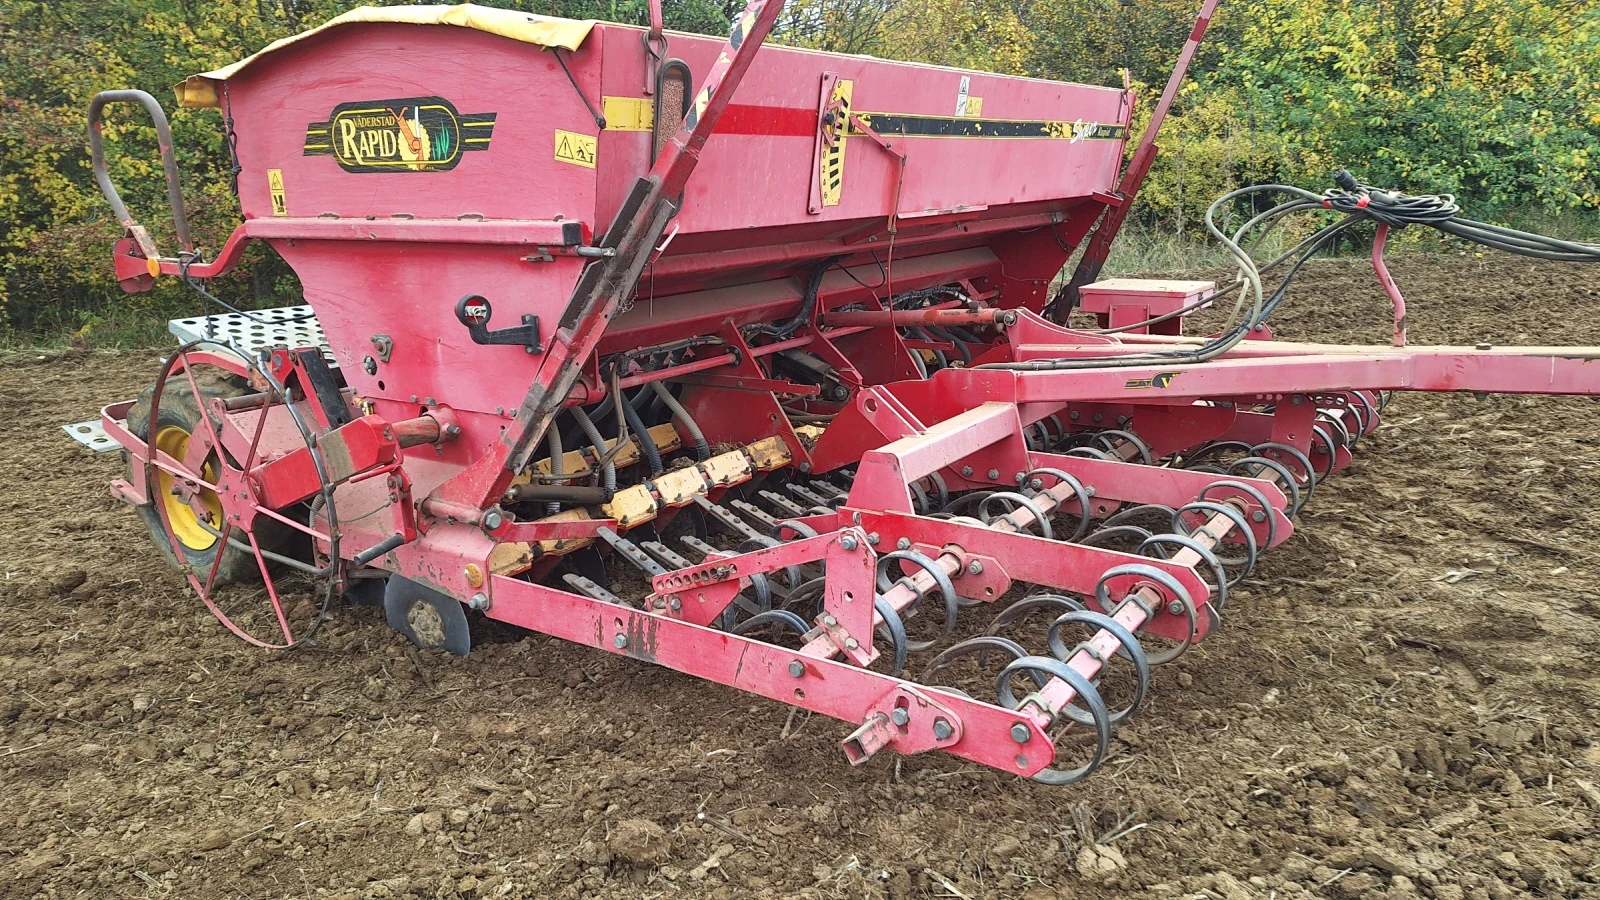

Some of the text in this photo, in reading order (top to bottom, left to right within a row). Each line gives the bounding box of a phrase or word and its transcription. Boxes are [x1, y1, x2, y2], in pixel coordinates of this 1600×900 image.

[837, 80, 842, 88] 0
[832, 92, 838, 102] 2
[353, 115, 395, 127] VÄDERSTAD
